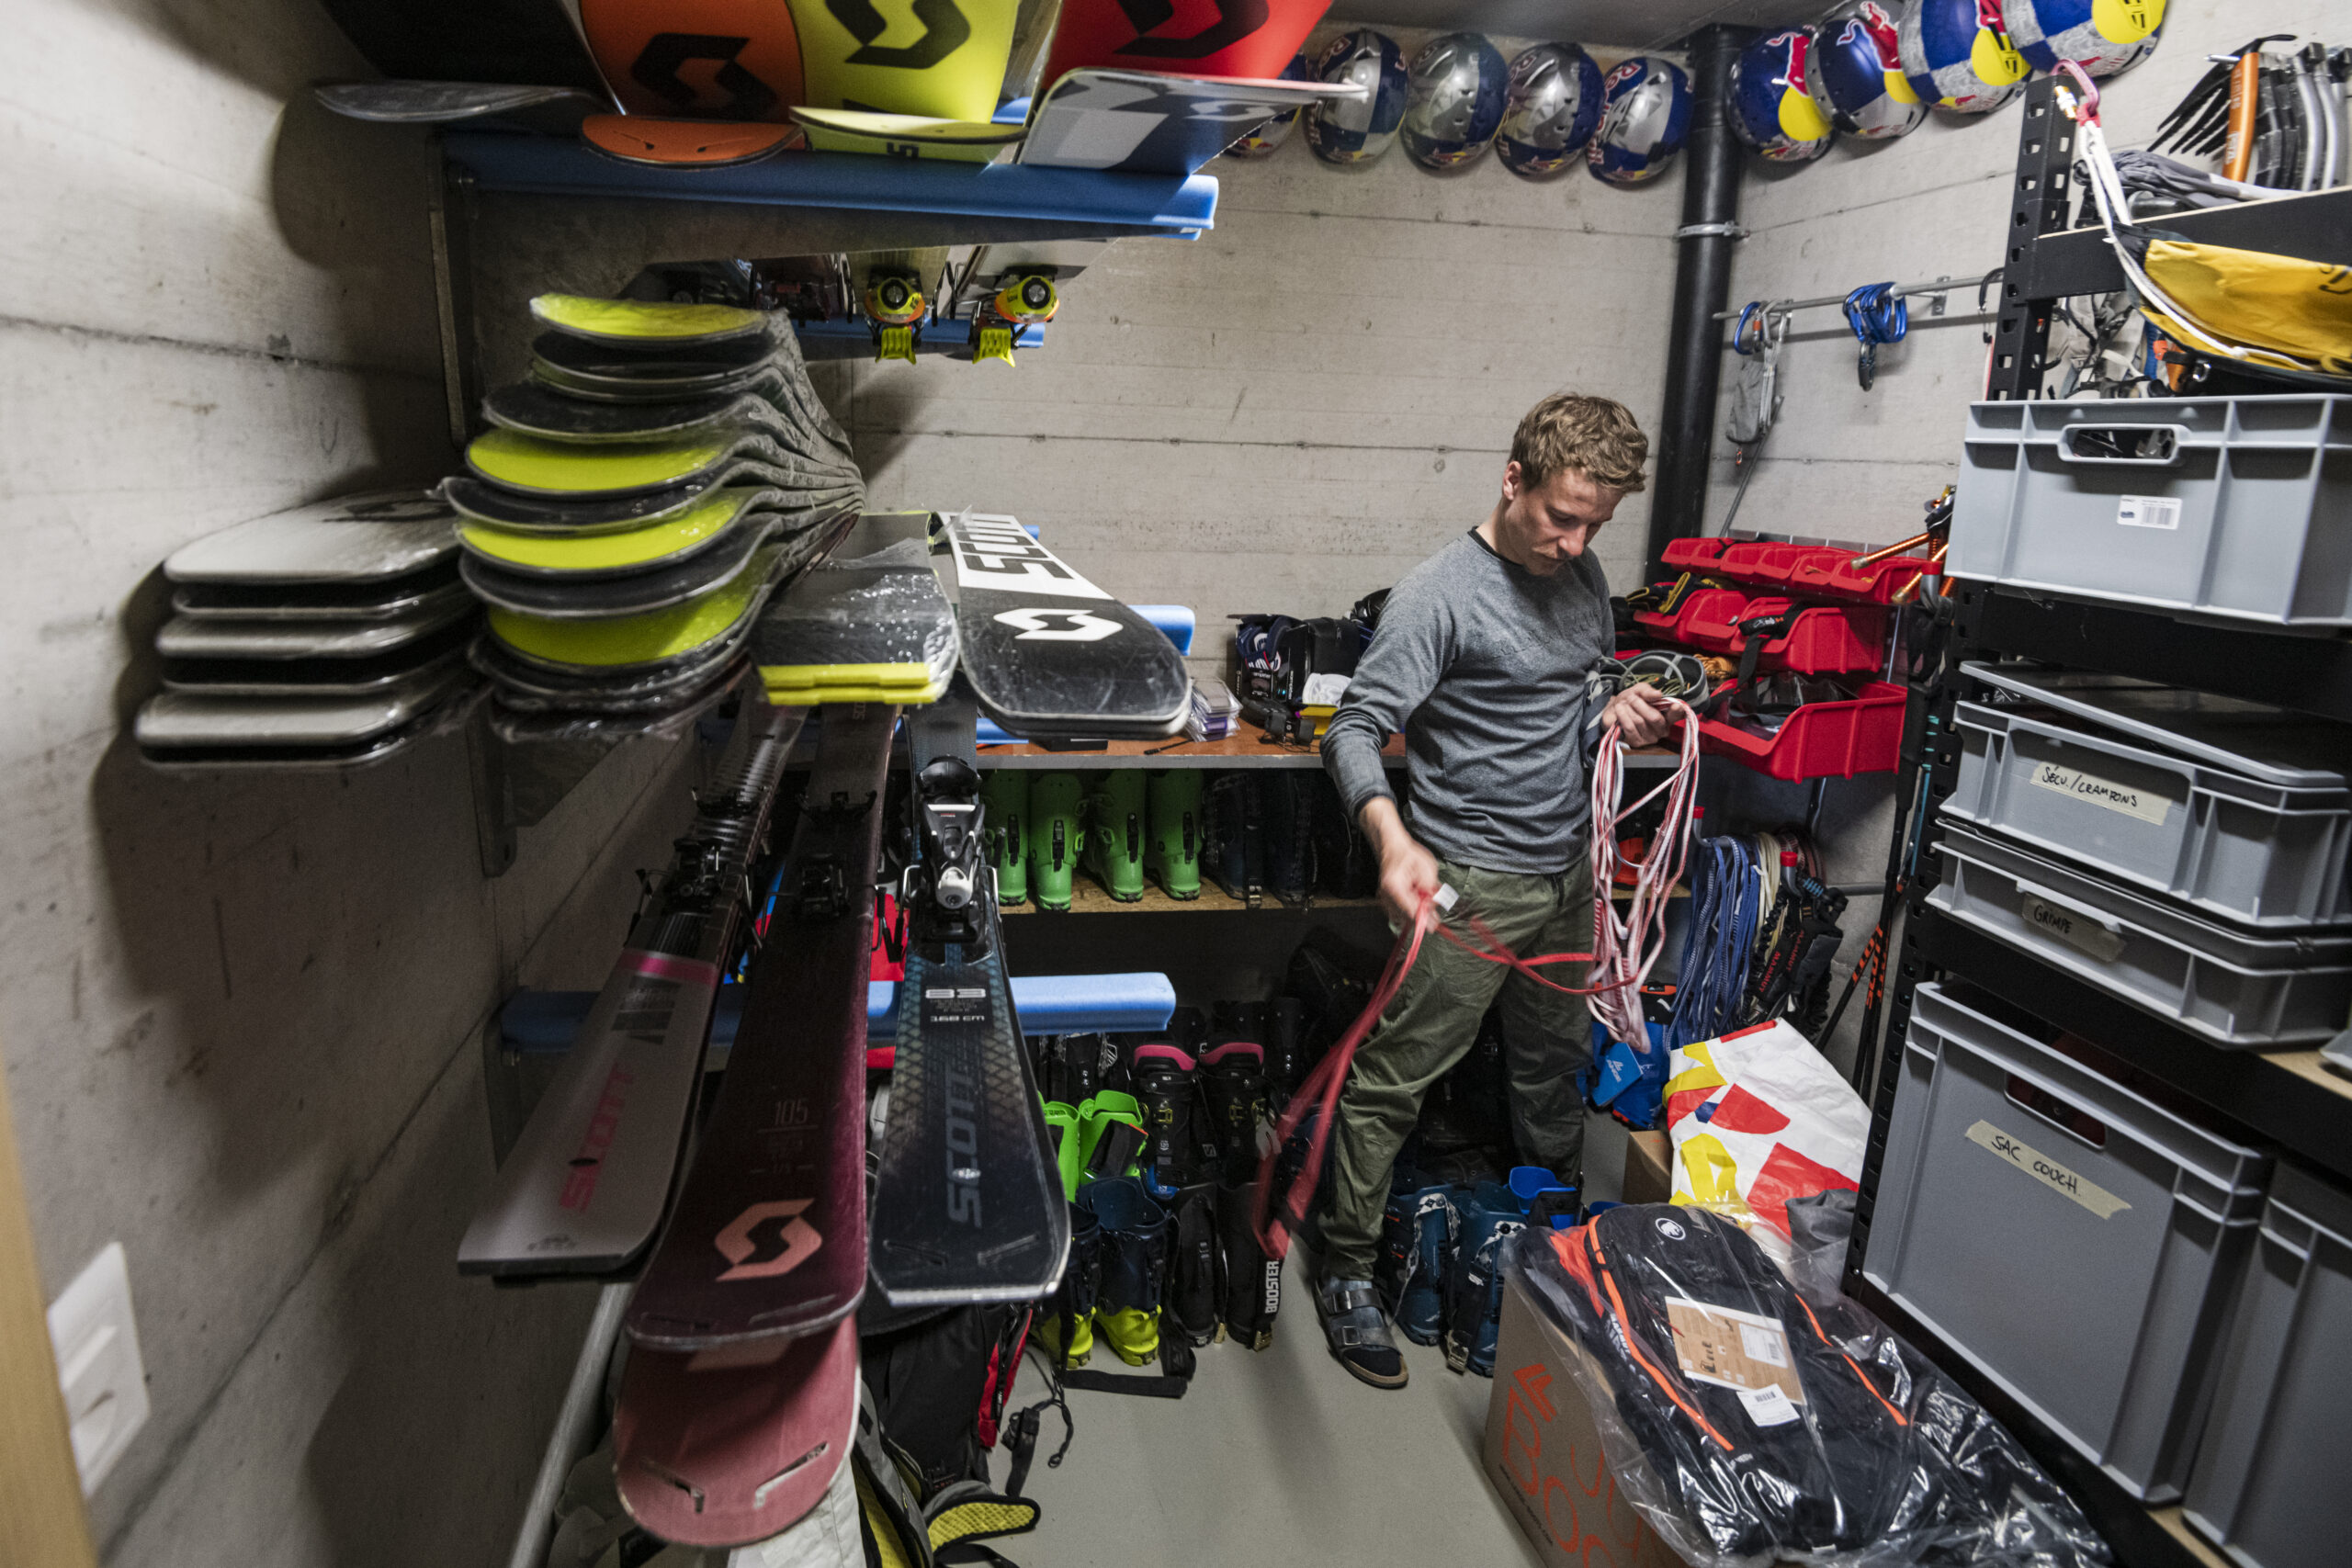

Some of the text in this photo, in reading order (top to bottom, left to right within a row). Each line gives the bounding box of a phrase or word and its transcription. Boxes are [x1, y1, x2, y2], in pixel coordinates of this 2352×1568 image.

[925, 987, 987, 999] 83
[1990, 1134, 2022, 1163] SAC
[1264, 1260, 1280, 1314] BOOSTER
